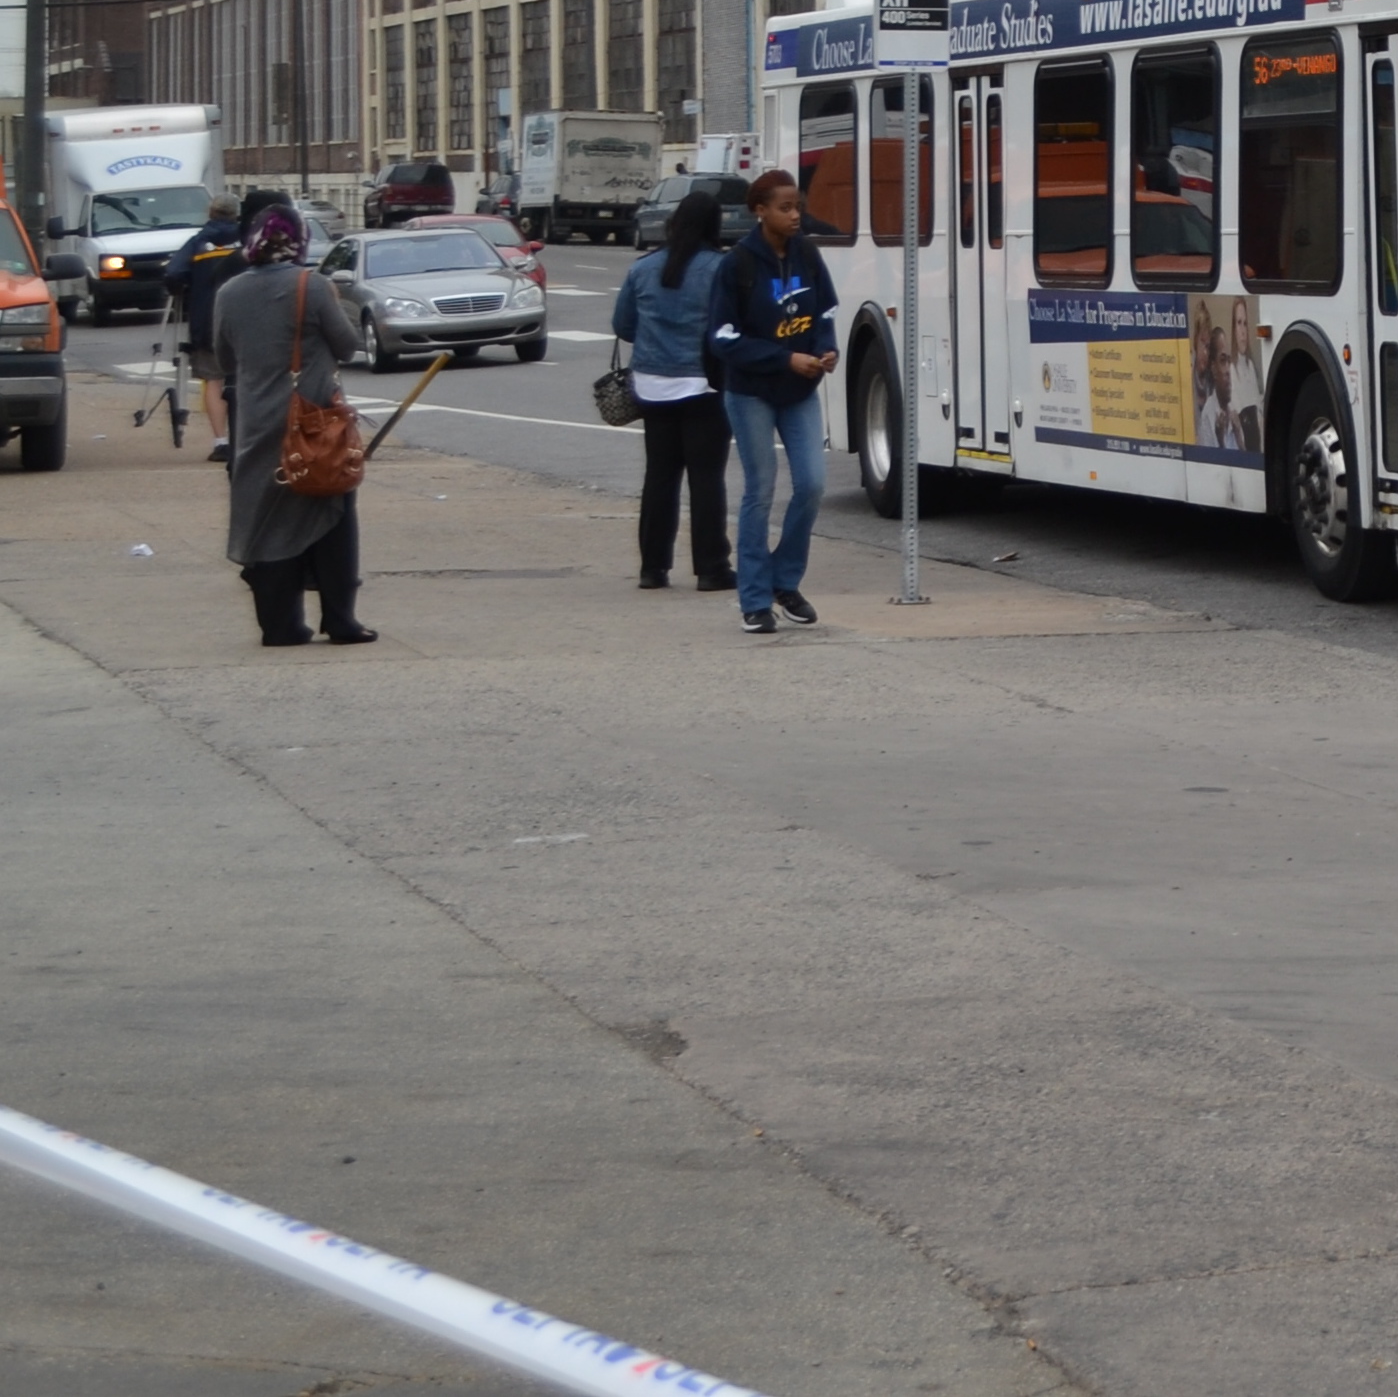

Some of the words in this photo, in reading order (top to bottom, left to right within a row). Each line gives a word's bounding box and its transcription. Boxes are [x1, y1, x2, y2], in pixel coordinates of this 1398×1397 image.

[882, 11, 906, 24] 400
[812, 28, 855, 70] Choose
[858, 23, 873, 64] La
[949, 7, 997, 55] aduate
[1254, 56, 1269, 85] 56
[1029, 298, 1054, 321] Choose
[1056, 299, 1065, 321] La
[1086, 300, 1097, 324] for
[1098, 301, 1134, 331] Programs
[1134, 304, 1144, 326] in
[1144, 303, 1187, 328] Education
